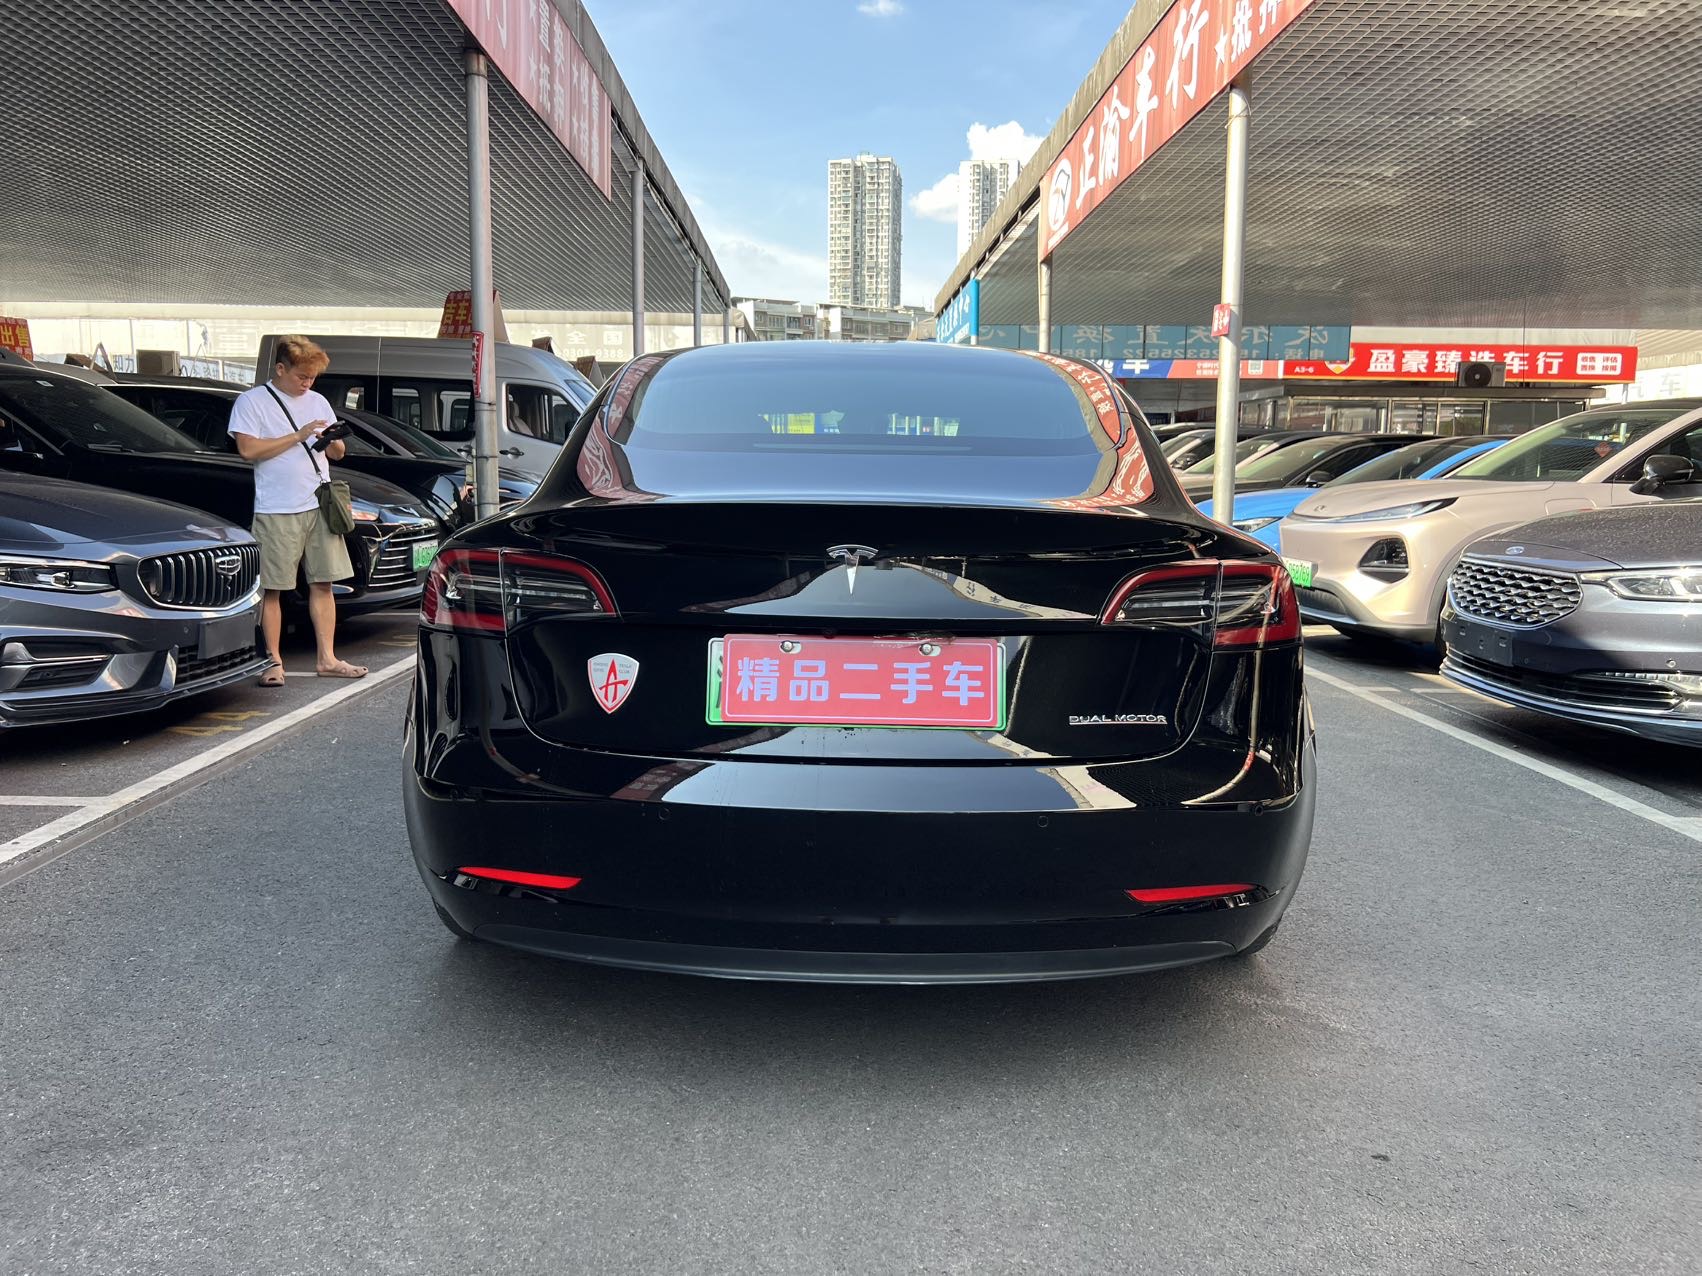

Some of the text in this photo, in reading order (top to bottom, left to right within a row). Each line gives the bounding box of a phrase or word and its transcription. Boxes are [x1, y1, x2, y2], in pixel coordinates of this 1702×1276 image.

[1294, 366, 1314, 374] A3-6
[736, 656, 985, 706] 精品二手车
[1068, 714, 1168, 723] DUAL MOTOR
